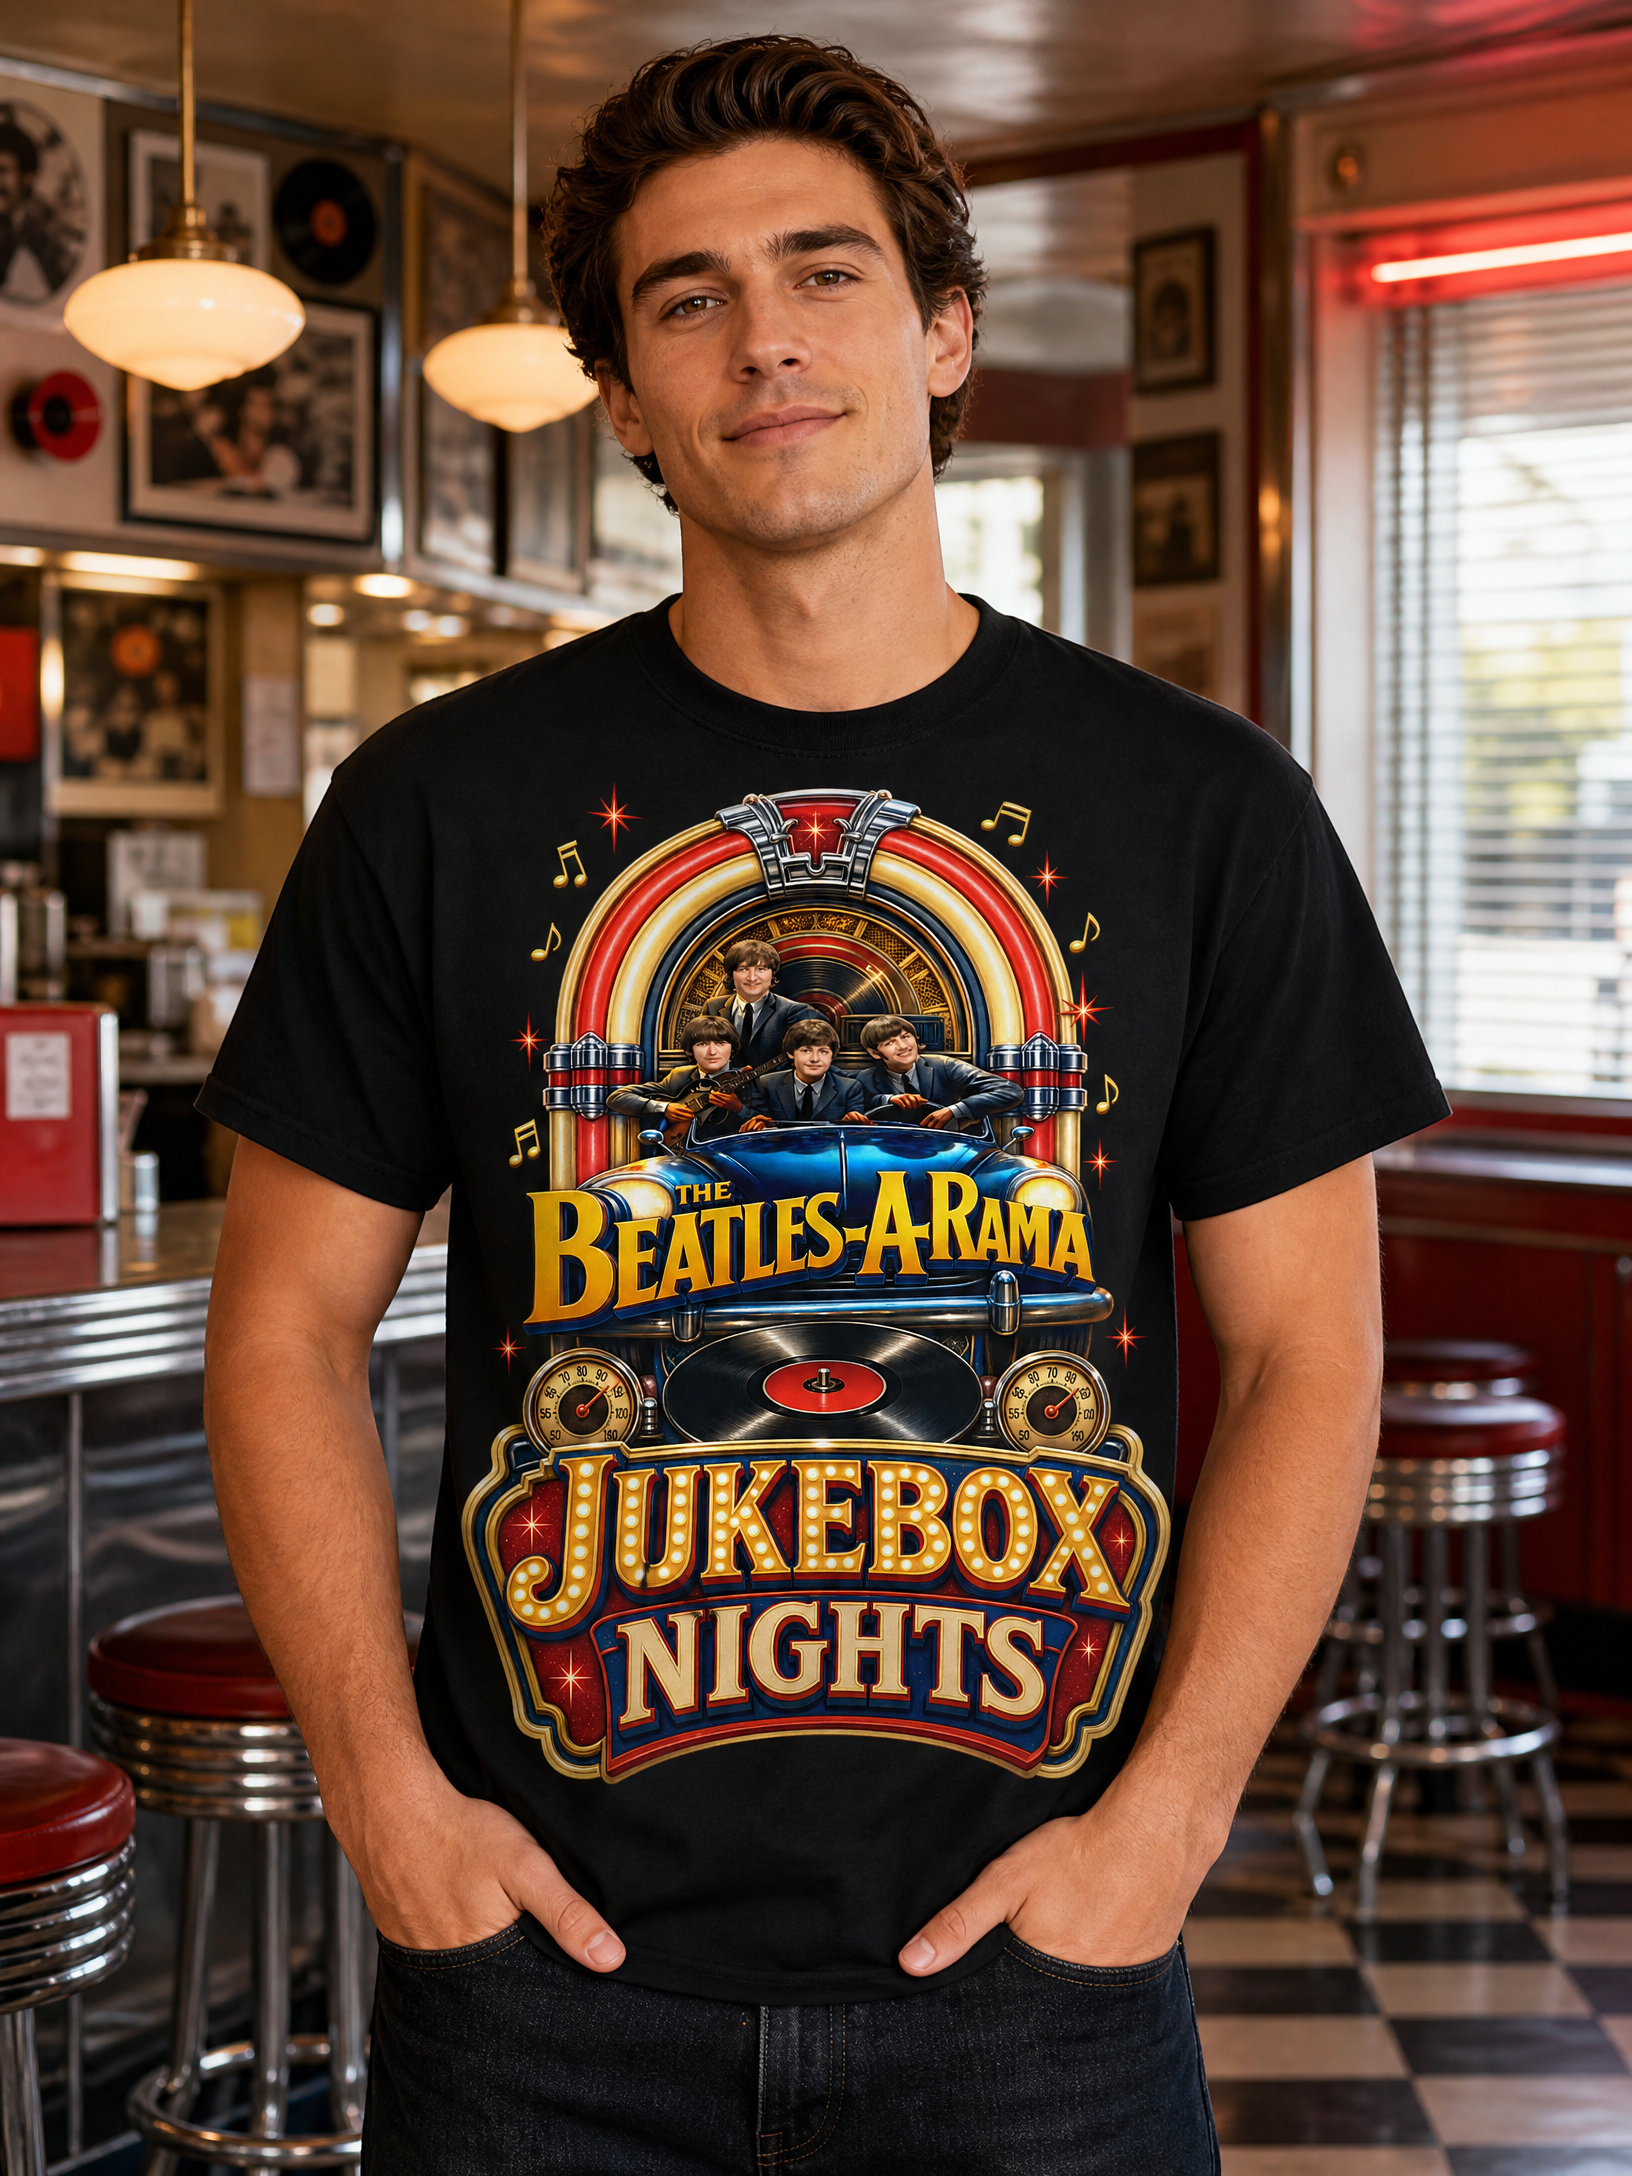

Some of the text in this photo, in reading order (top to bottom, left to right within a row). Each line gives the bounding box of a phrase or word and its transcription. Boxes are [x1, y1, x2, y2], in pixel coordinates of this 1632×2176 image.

[675, 1180, 731, 1206] THE
[558, 1370, 571, 1384] 70
[576, 1365, 588, 1377] 80
[595, 1368, 609, 1382] 90
[1046, 1367, 1058, 1379] 70
[1008, 1407, 1020, 1420] 55
[506, 1453, 1132, 1629] JUKEBOX
[617, 1599, 1046, 1726] NIGHTS
